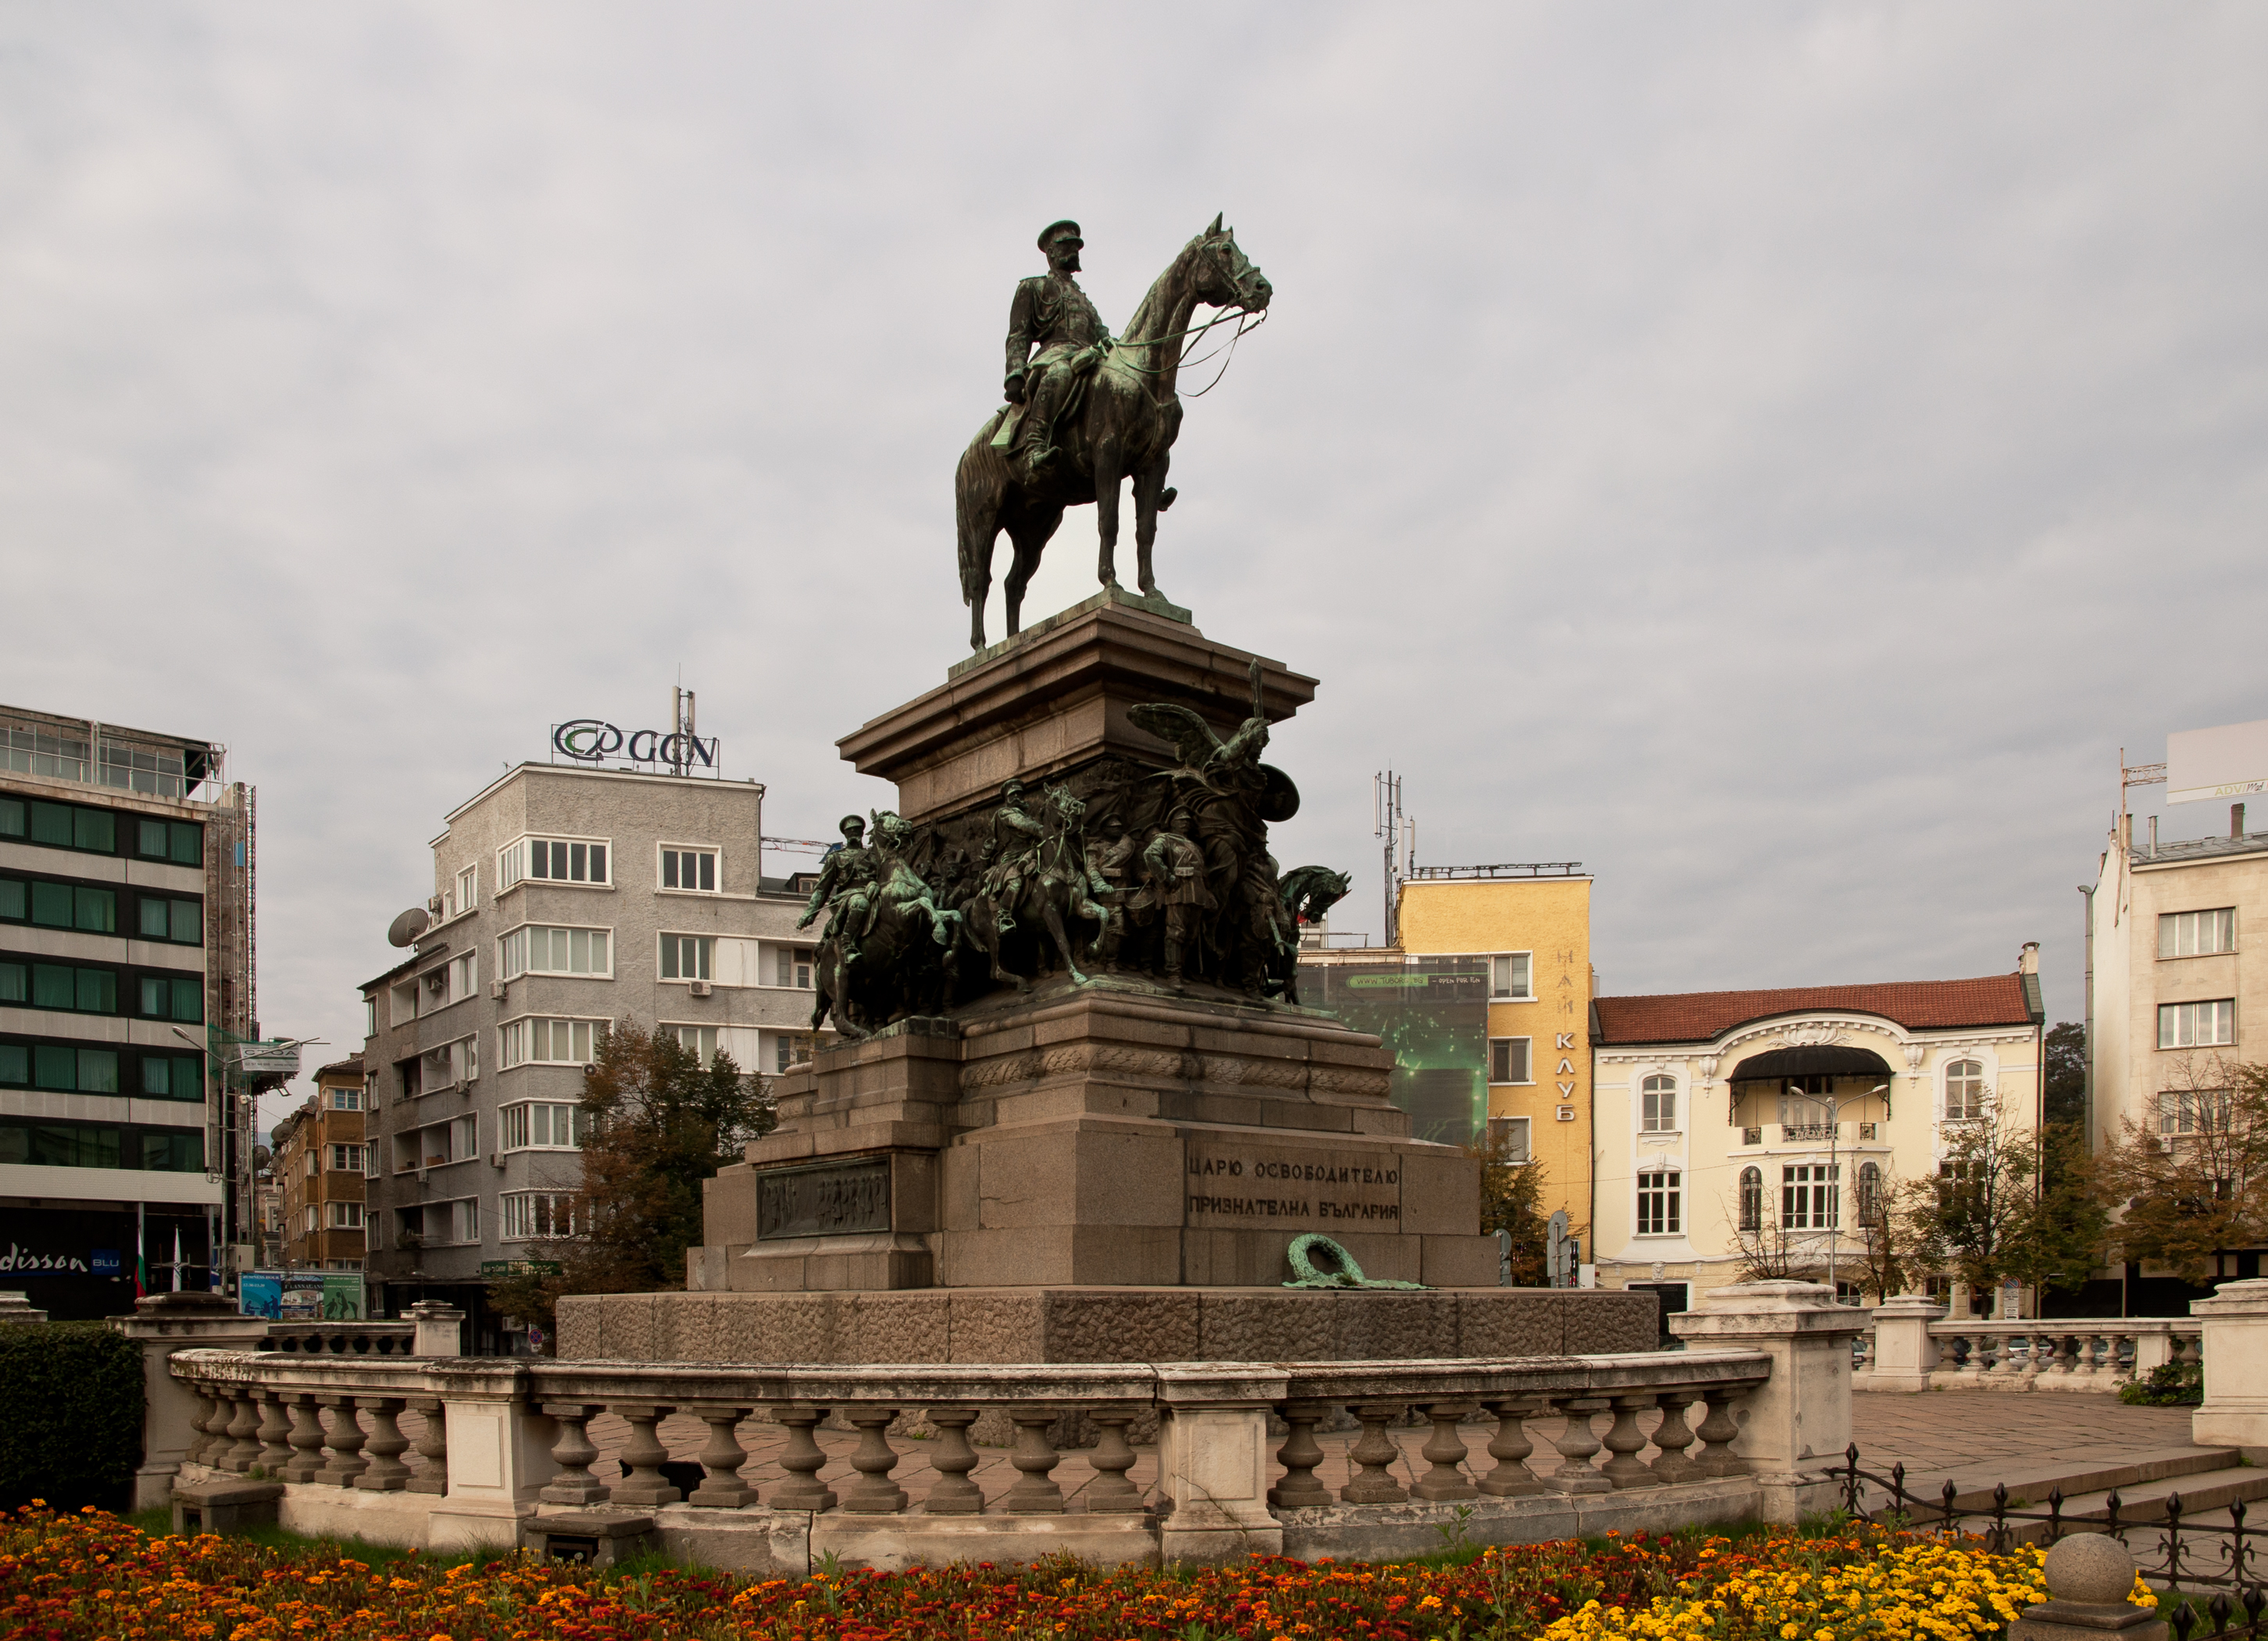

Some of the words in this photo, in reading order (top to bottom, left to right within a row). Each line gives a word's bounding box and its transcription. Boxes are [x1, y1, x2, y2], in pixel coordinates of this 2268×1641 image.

[1555, 1032, 1575, 1121] КЛУБ
[1188, 1158, 1243, 1176] ЦАРЮ
[1255, 1162, 1398, 1184] ОСВОБОДИТЕЛЮ
[1188, 1195, 1310, 1217] ПРИЗНАТЕЛНА
[1319, 1201, 1398, 1220] БЪЛГАРИЯ
[92, 1258, 120, 1267] BLU
